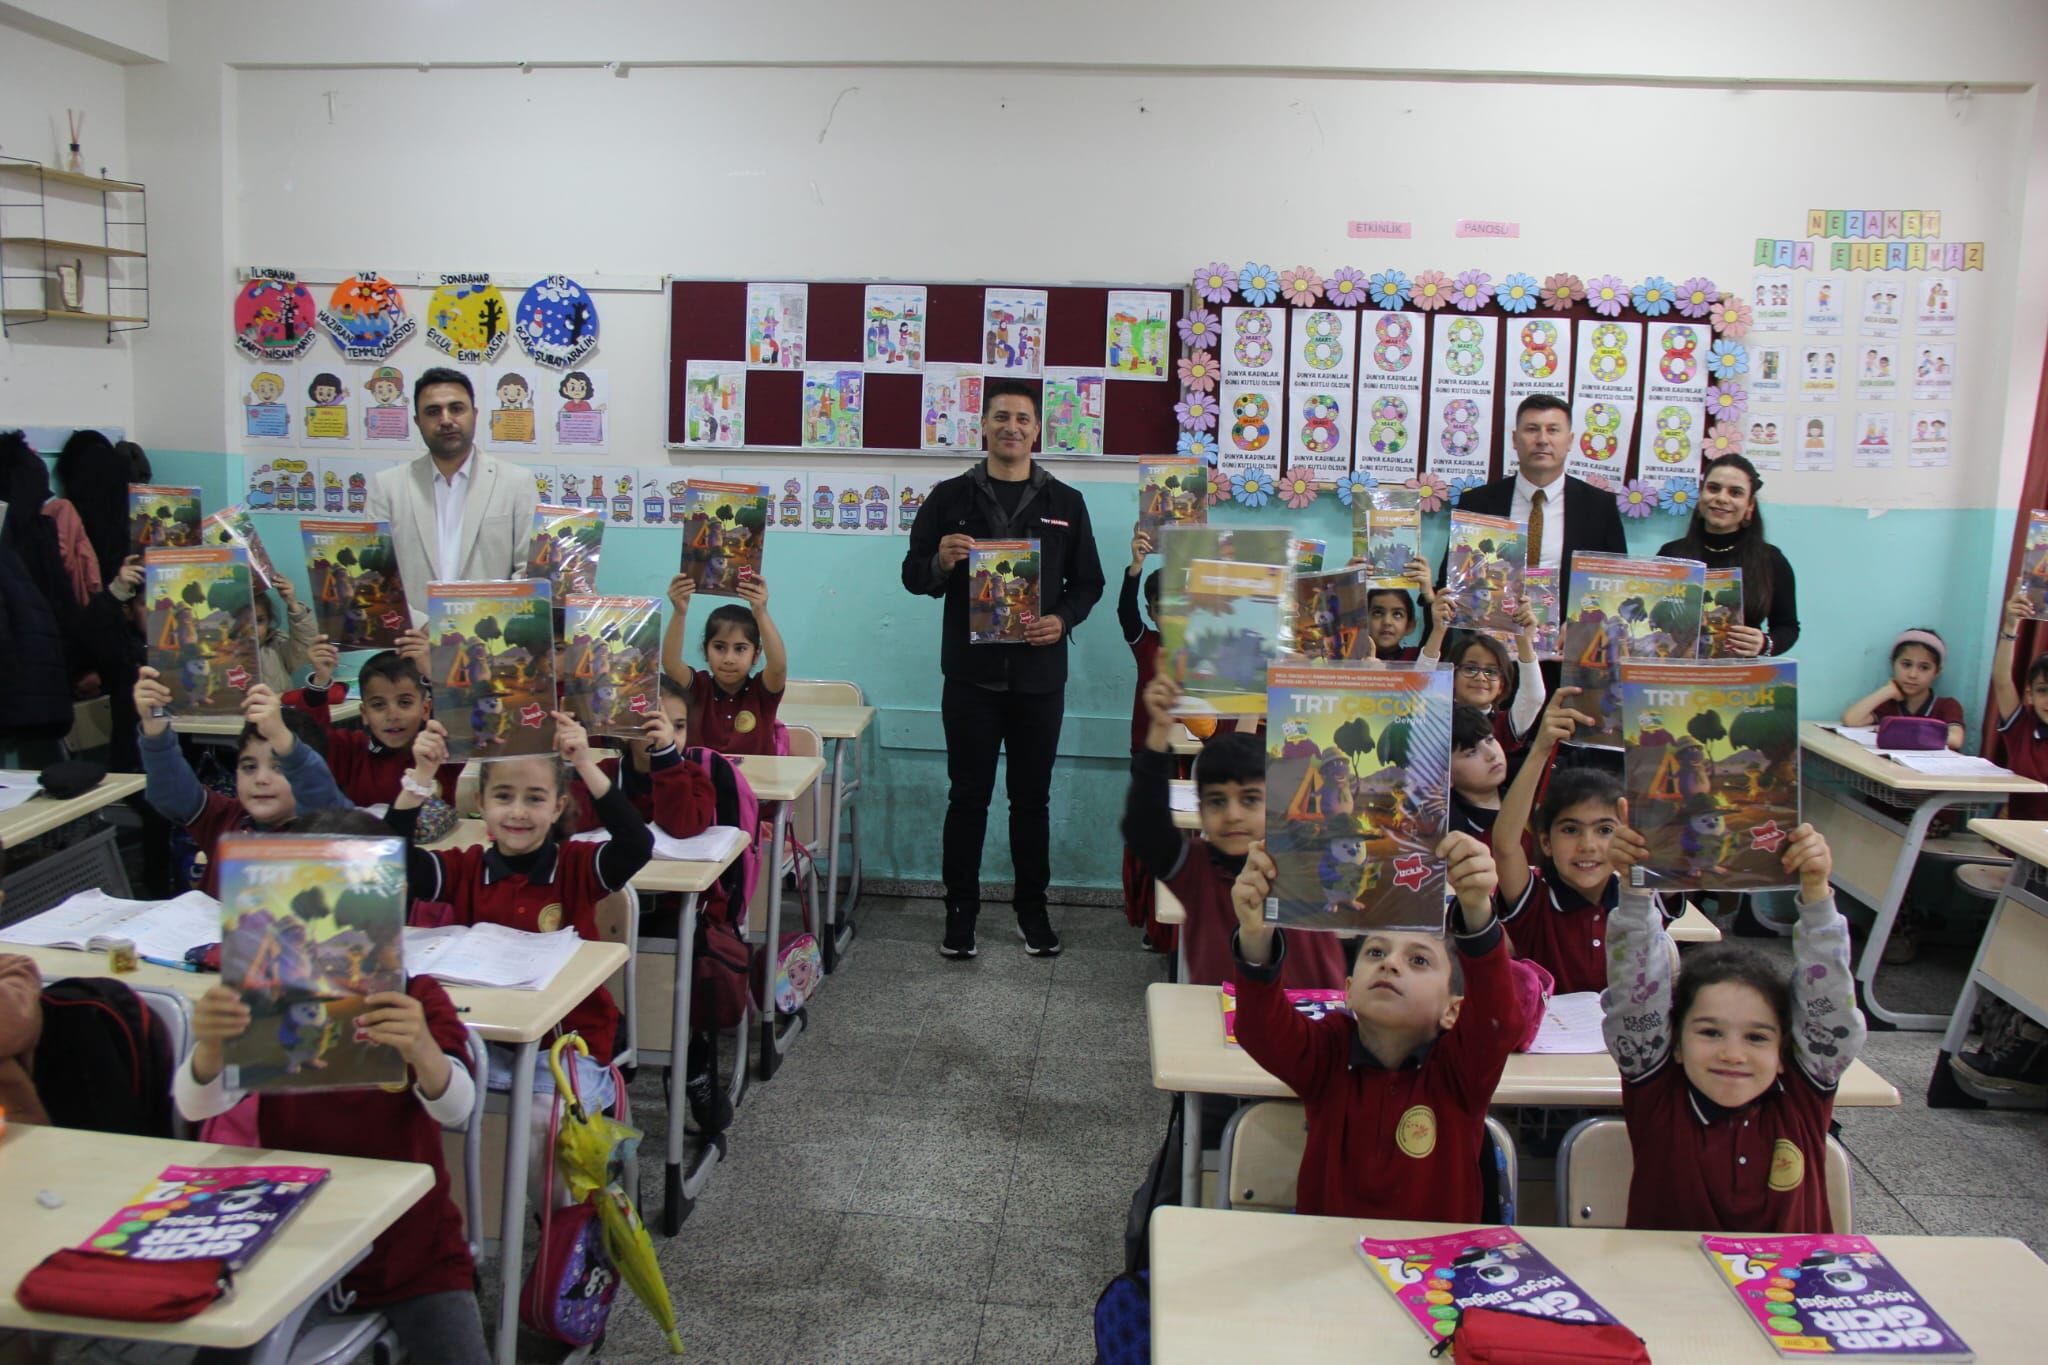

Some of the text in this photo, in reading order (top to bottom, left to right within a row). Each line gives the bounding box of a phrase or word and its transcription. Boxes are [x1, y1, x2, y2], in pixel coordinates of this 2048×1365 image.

[1356, 223, 1509, 235] ETKİNLİK PANOSU
[1811, 215, 1935, 230] NEZAKET
[251, 266, 296, 280] İLKBAHAR
[359, 272, 377, 281] YAZ
[440, 273, 489, 285] SONBAHAR
[426, 327, 451, 353] EYLÜL
[485, 332, 506, 359] KASIM
[566, 336, 595, 364] ARALIK
[458, 349, 480, 361] EKİM
[1588, 577, 1624, 593] TRT
[442, 602, 476, 614] TRT
[1290, 694, 1340, 714] TRT
[1643, 688, 1689, 707] TRT
[1377, 1256, 1423, 1285] 2
[1722, 1254, 1767, 1280] 2
[1456, 1275, 1566, 1309] Hayat Bilgisi
[1796, 1290, 1916, 1310] Hayat Bilgisi
[1808, 1304, 1928, 1332] GICIR
[1832, 1326, 1945, 1350] GICIR
